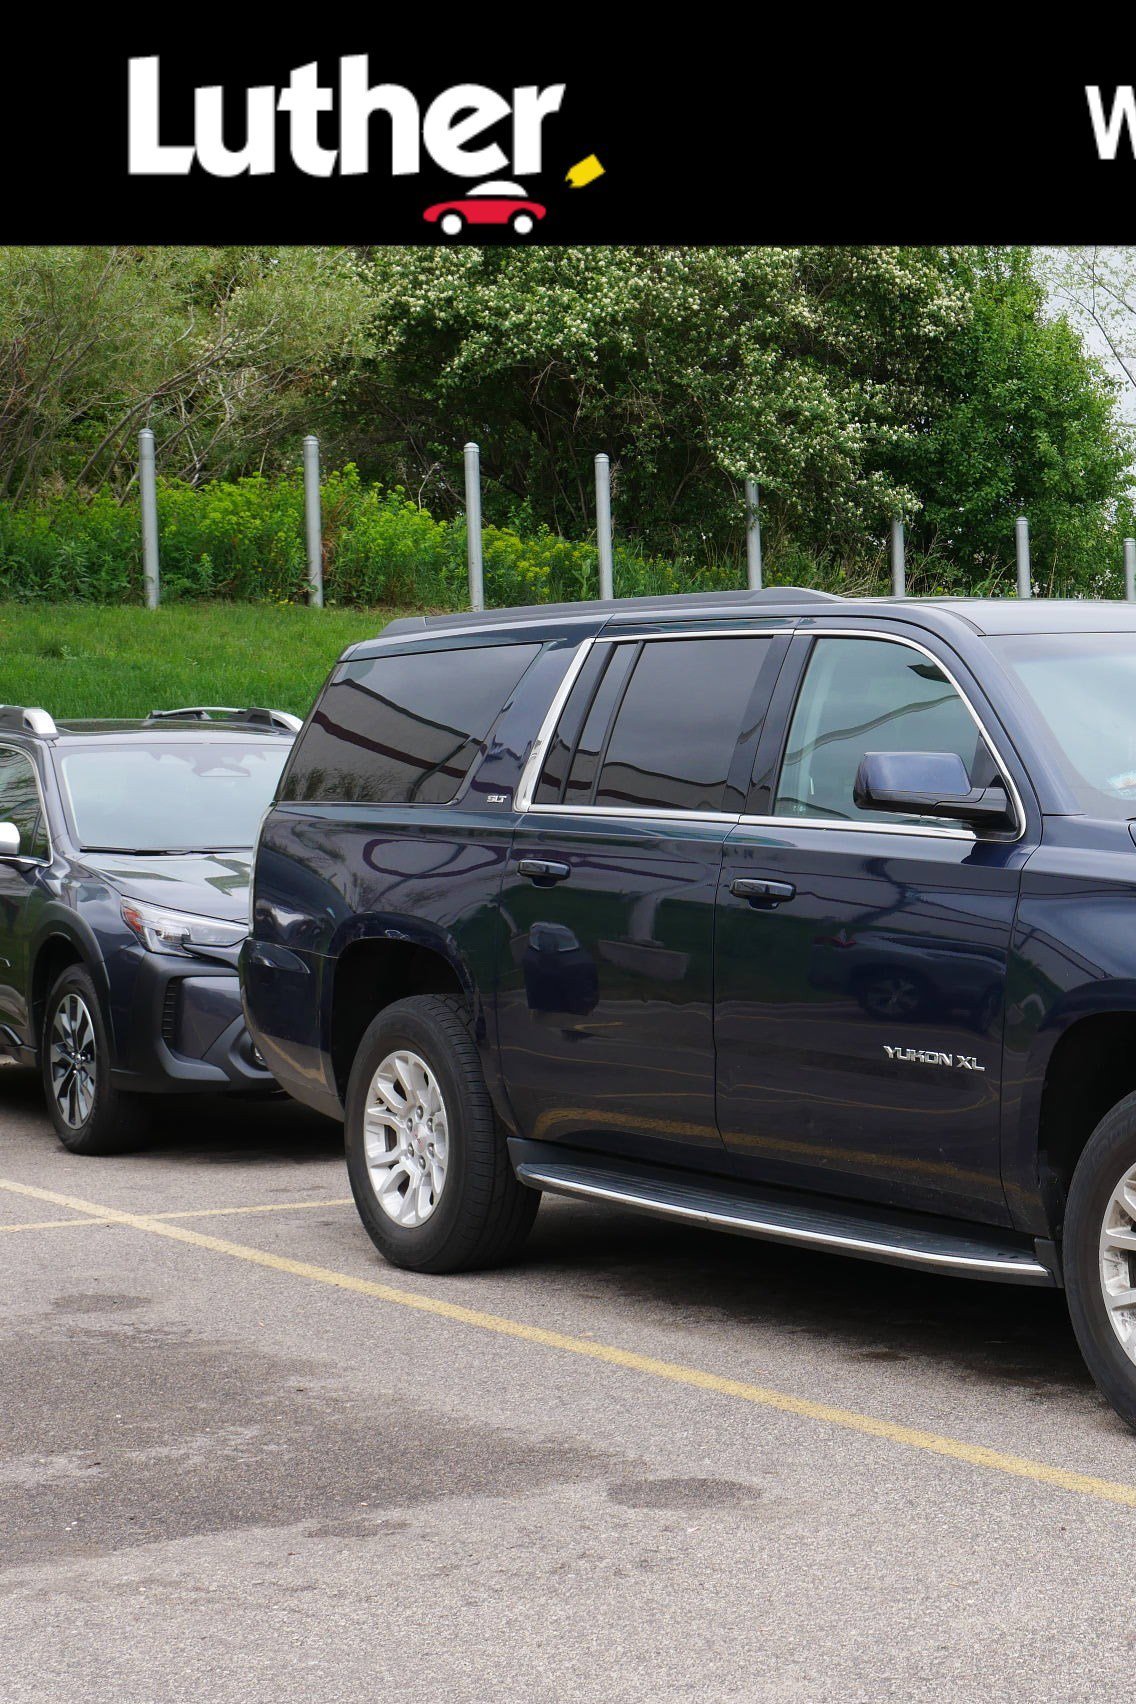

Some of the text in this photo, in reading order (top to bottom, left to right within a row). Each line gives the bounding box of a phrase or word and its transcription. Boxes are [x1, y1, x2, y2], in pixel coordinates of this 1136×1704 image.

[487, 795, 507, 803] SLT
[883, 1045, 986, 1072] YUKON XL
